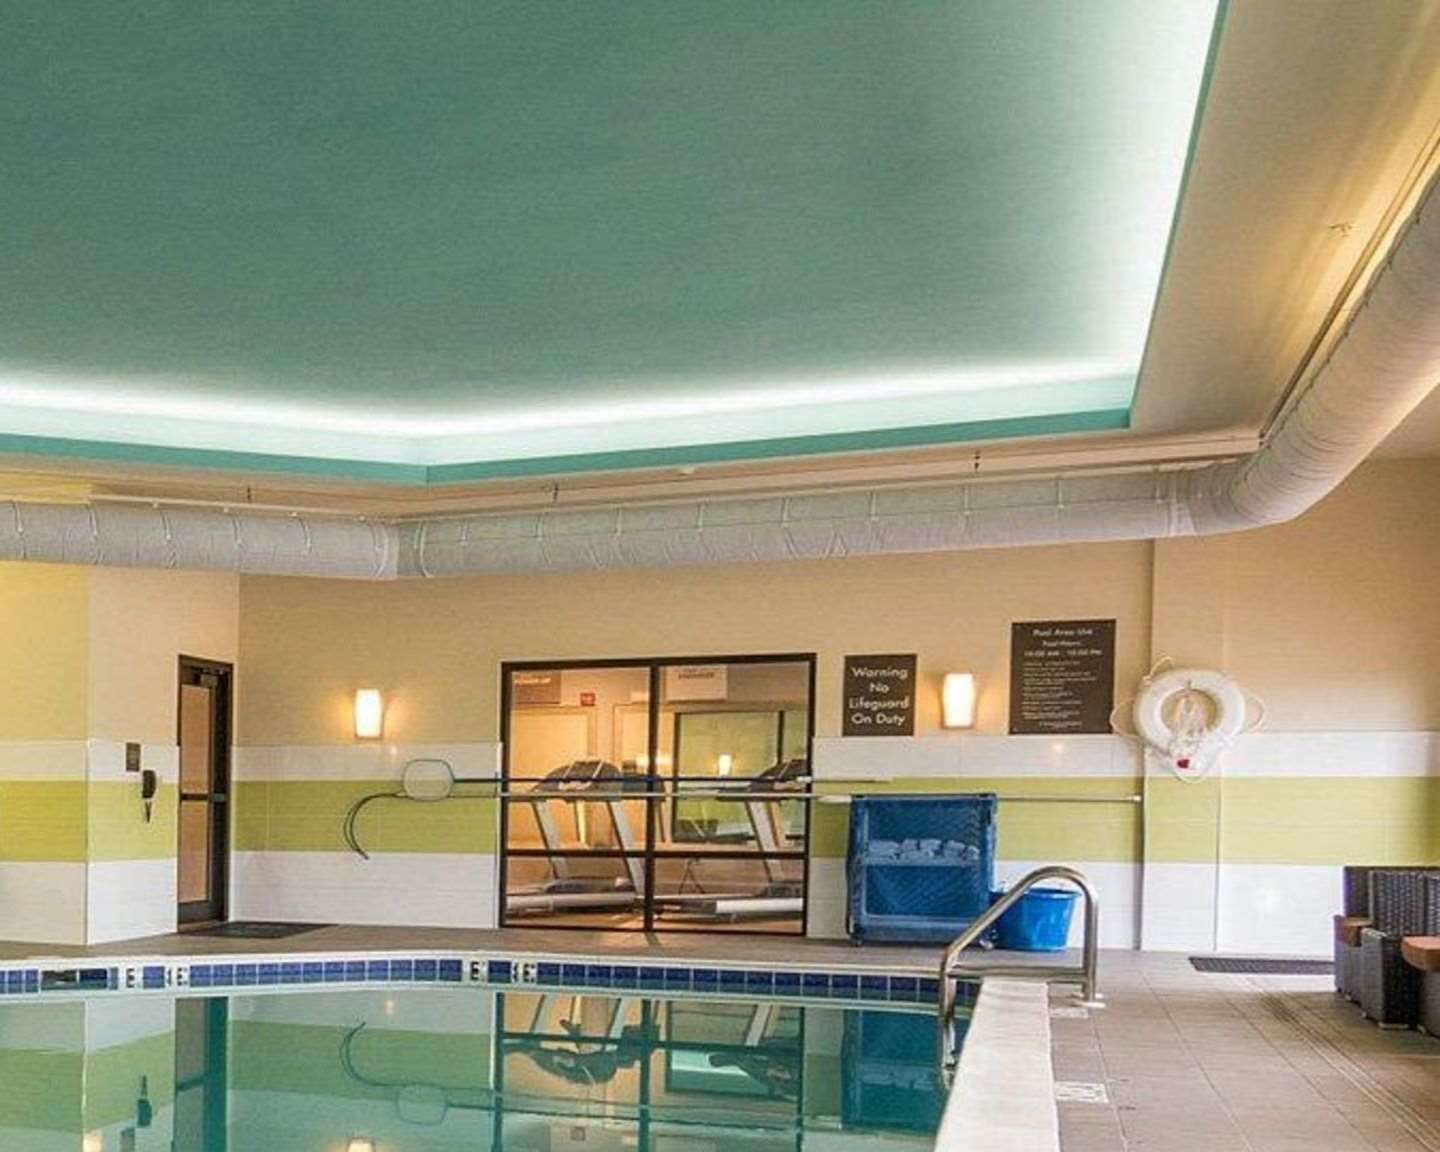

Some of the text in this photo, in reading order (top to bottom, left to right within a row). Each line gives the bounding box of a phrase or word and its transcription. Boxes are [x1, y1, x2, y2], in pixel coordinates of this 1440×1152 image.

[851, 666, 908, 680] Warning
[869, 681, 890, 693] No
[848, 695, 910, 711] Lifeguard
[851, 712, 906, 726] On Duty
